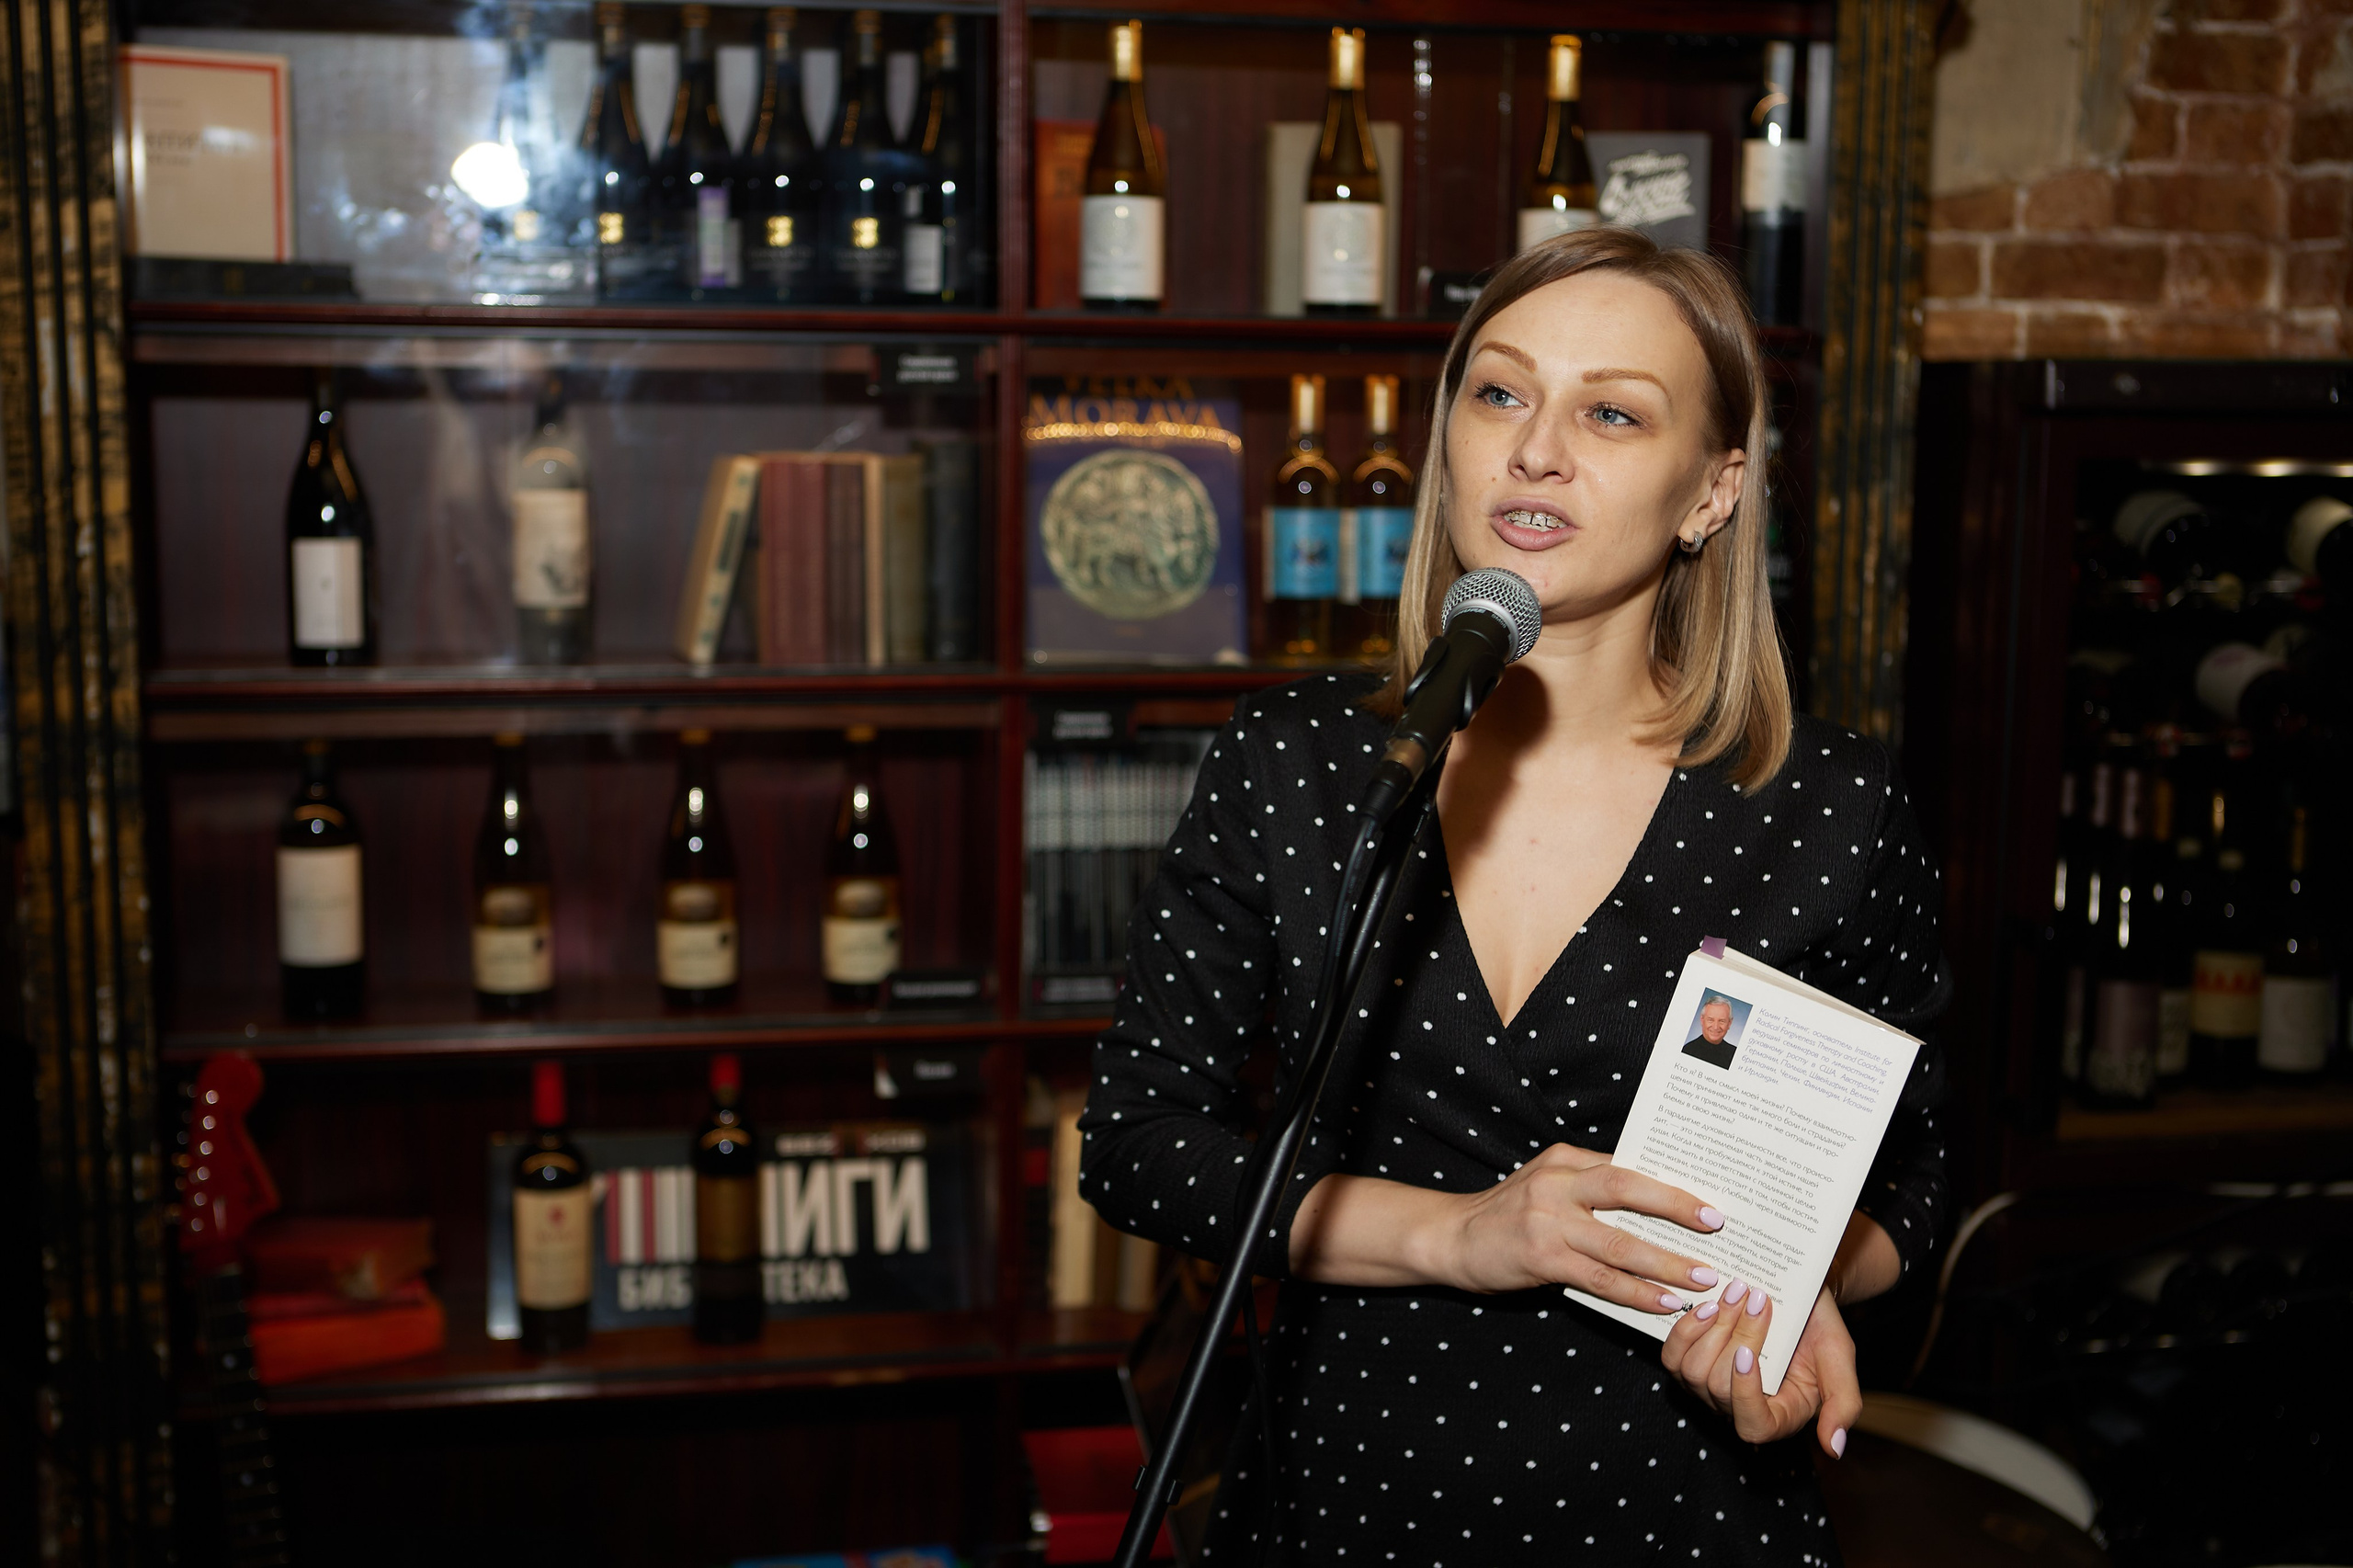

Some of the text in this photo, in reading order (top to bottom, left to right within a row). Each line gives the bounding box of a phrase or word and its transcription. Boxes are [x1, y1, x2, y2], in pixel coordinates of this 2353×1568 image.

[1662, 1092, 1686, 1106] блемы
[1690, 1105, 1711, 1116] свою
[1710, 1112, 1735, 1124] жизнь?
[1665, 1081, 1694, 1099] Почему
[1737, 1111, 1757, 1122] одни
[1764, 1121, 1773, 1130] те
[1772, 1126, 1784, 1134] же
[1783, 1131, 1816, 1148] ситуации
[1821, 1147, 1839, 1158] про-
[1668, 1074, 1693, 1086] шения
[1732, 1097, 1747, 1108] мне
[1747, 1103, 1760, 1112] так
[1759, 1108, 1783, 1122] много
[1782, 1117, 1801, 1130] боли
[1673, 1062, 1688, 1074] Кто
[1703, 1075, 1718, 1085] чем
[1717, 1081, 1740, 1093] смысл
[1739, 1089, 1760, 1101] моей
[1759, 1097, 1786, 1110] жизни?
[1784, 1106, 1813, 1124] Почему
[1645, 1135, 1679, 1152] начинаем
[1678, 1149, 1699, 1160] жить
[1793, 1198, 1816, 1211] целью
[1670, 1131, 1692, 1146] Когда
[1692, 1142, 1704, 1151] мы
[1760, 1170, 1779, 1182] этой
[1804, 1190, 1814, 1199] то
[1679, 1126, 1693, 1135] это
[1744, 1151, 1763, 1164] часть
[1763, 1160, 1797, 1178] эволюции
[1796, 1176, 1819, 1188] нашей
[1699, 1123, 1735, 1140] духовной
[1788, 1160, 1802, 1169] что
[1802, 1165, 1835, 1183] происхо-
[1642, 1145, 1665, 1158] нашей
[1688, 1164, 1720, 1179] которая
[1719, 1176, 1748, 1190] состоит
[1769, 1198, 1791, 1211] чтобы
[1790, 1208, 1819, 1224] постичь
[1689, 1175, 1721, 1192] природу
[1720, 1186, 1754, 1206] (Любовь)
[1754, 1201, 1774, 1215] через
[1684, 1233, 1714, 1248] поднять
[1713, 1244, 1730, 1256] наш
[1749, 1238, 1784, 1258] надежные
[1782, 1255, 1802, 1267] прак-
[1758, 1255, 1789, 1273] которые
[1781, 1243, 1806, 1256] «ради-
[1763, 1280, 1782, 1293] наши
